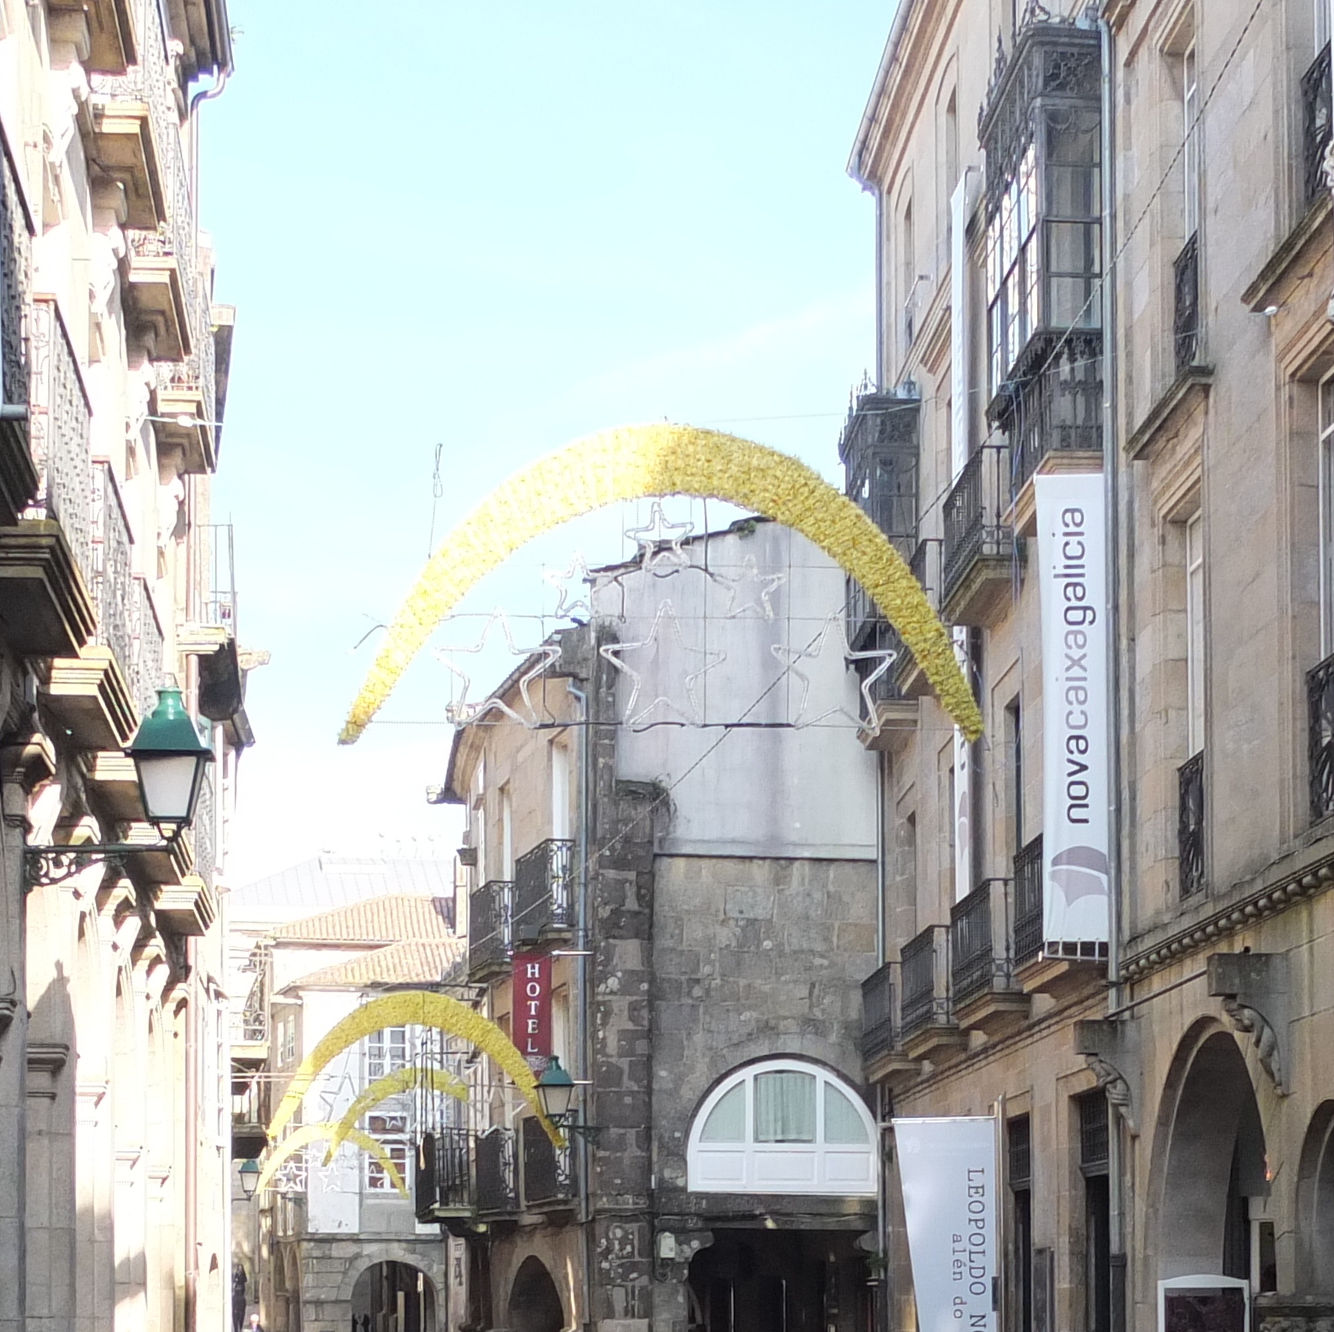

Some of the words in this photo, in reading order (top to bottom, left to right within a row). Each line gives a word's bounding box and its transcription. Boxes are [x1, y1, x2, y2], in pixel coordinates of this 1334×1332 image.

[1053, 506, 1096, 825] novacaixagalicia
[526, 963, 541, 1053] HOTEL
[952, 1233, 967, 1282] alén
[967, 1167, 987, 1297] LEOPOLDO
[952, 1296, 968, 1319] do
